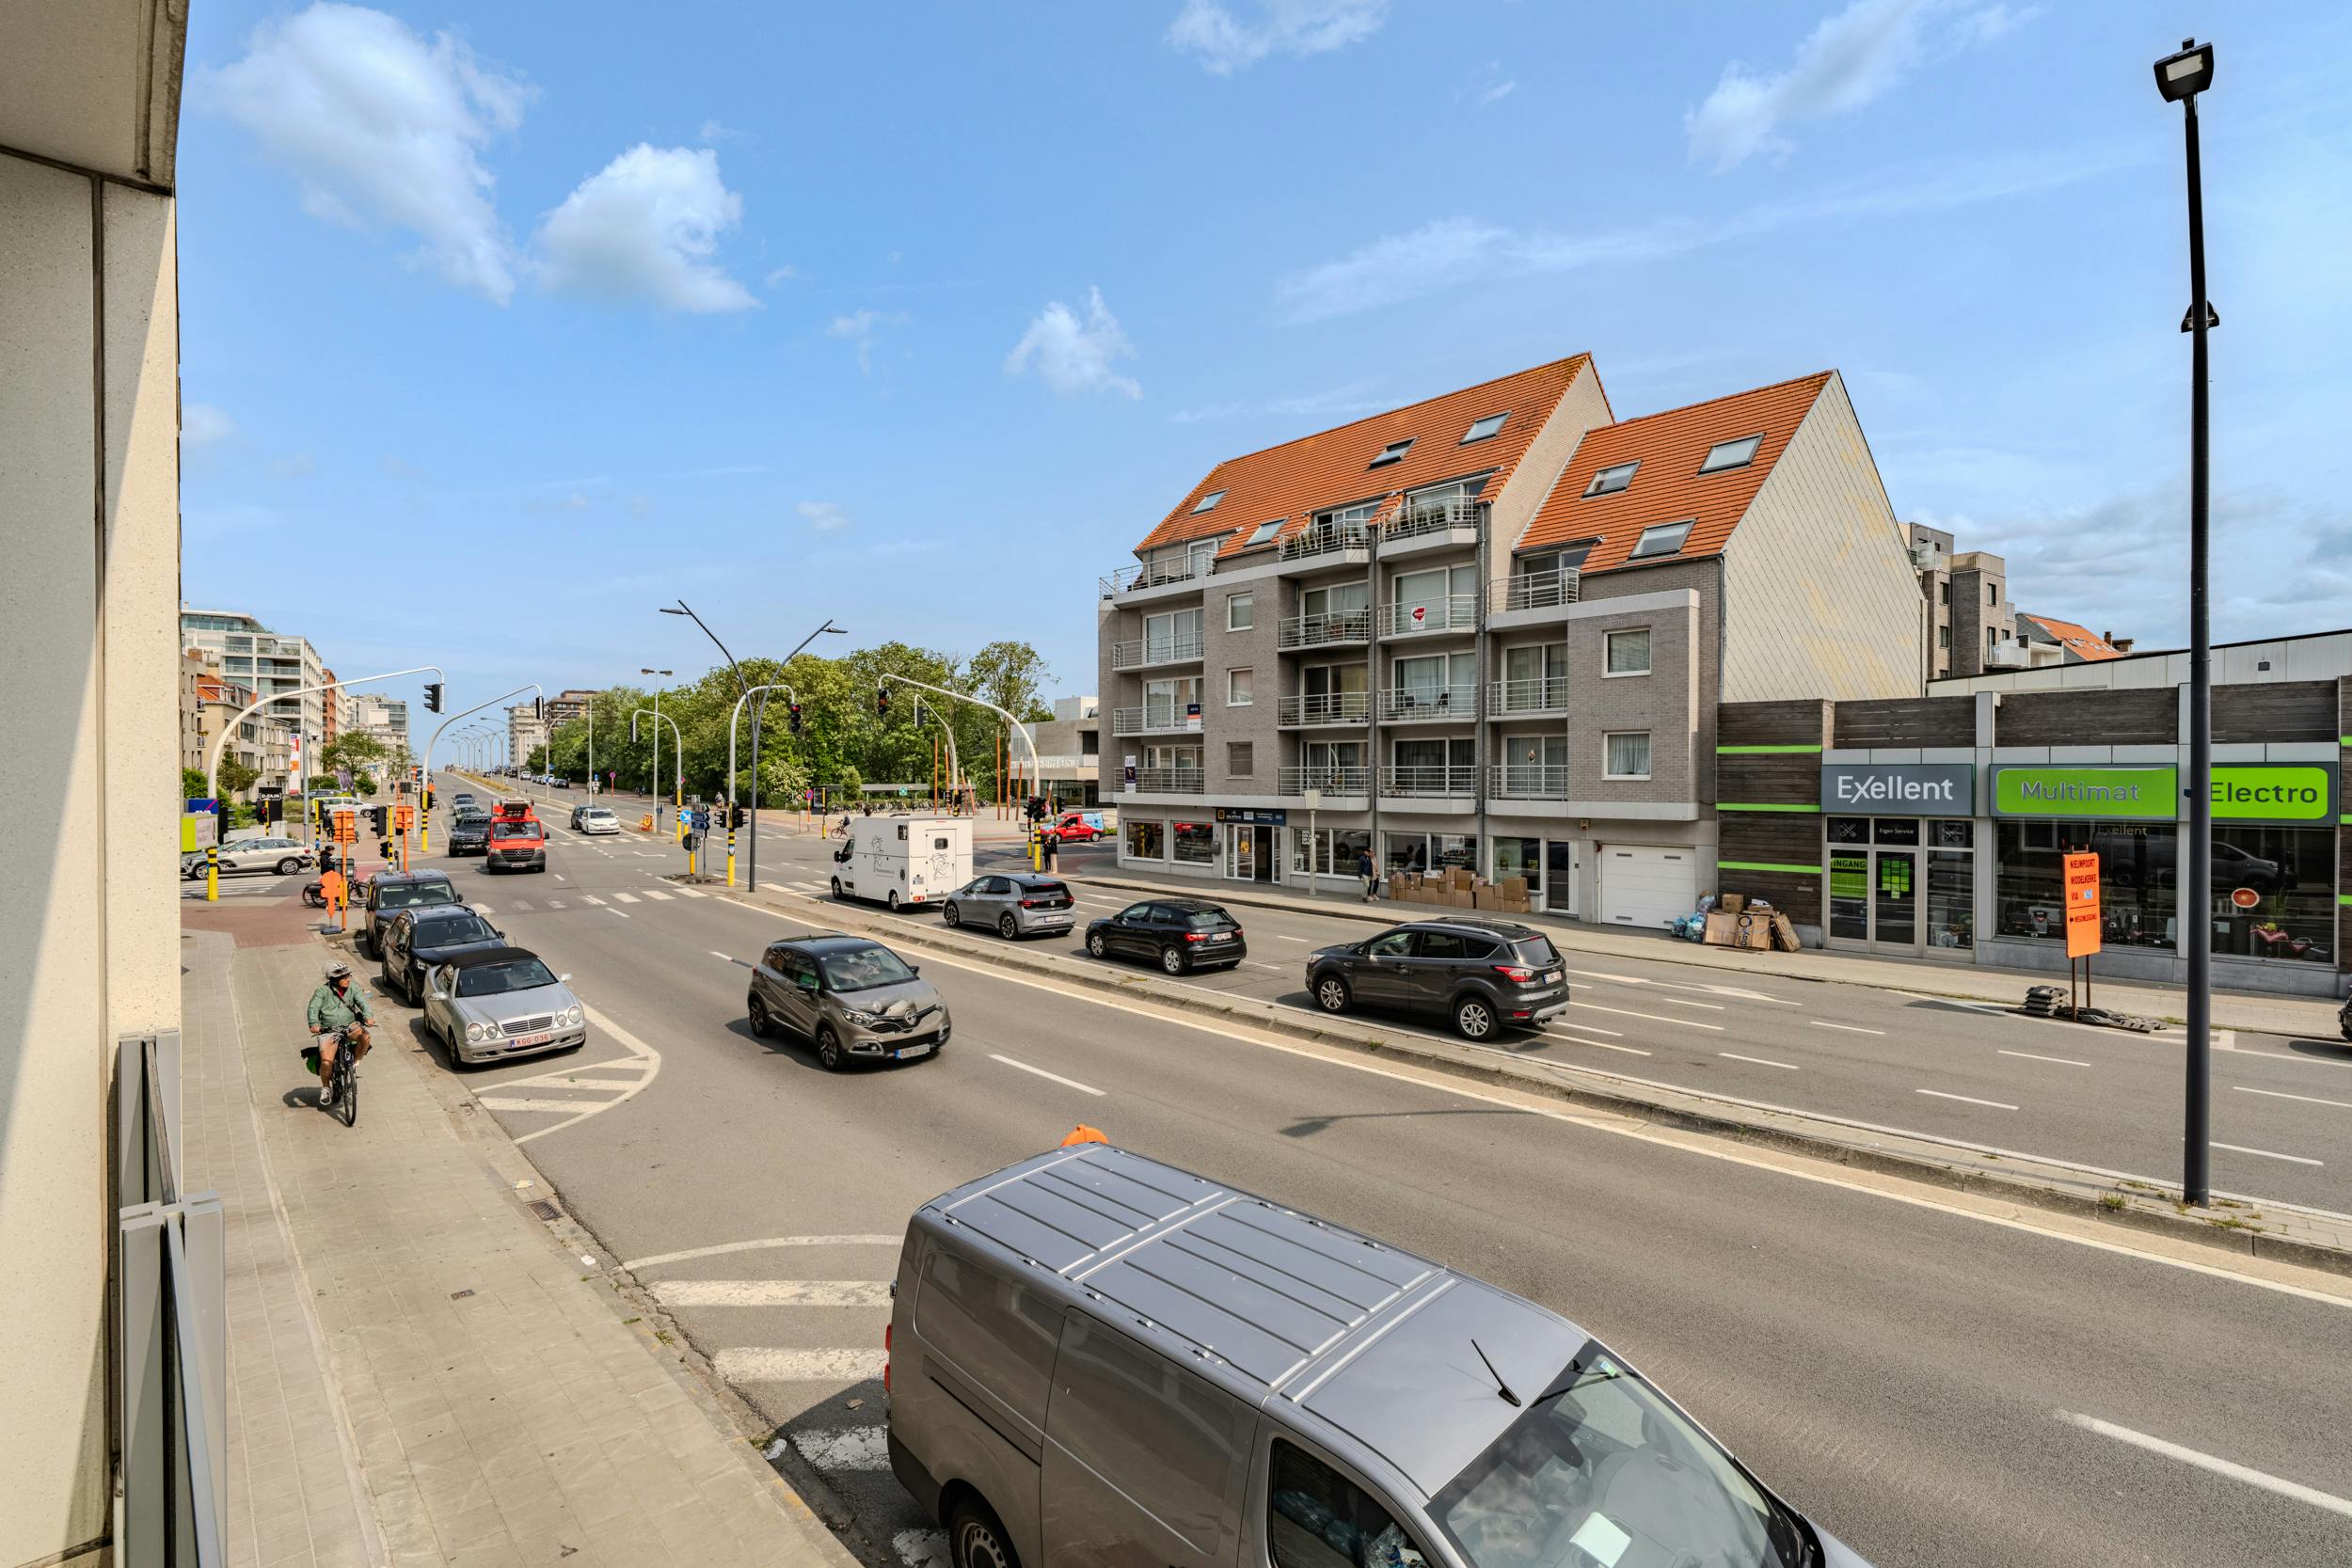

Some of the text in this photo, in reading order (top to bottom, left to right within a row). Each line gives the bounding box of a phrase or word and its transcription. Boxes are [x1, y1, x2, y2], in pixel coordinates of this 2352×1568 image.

[1837, 775, 1954, 804] Exellent
[2021, 781, 2139, 800] Multimat
[2210, 782, 2318, 803] Electro
